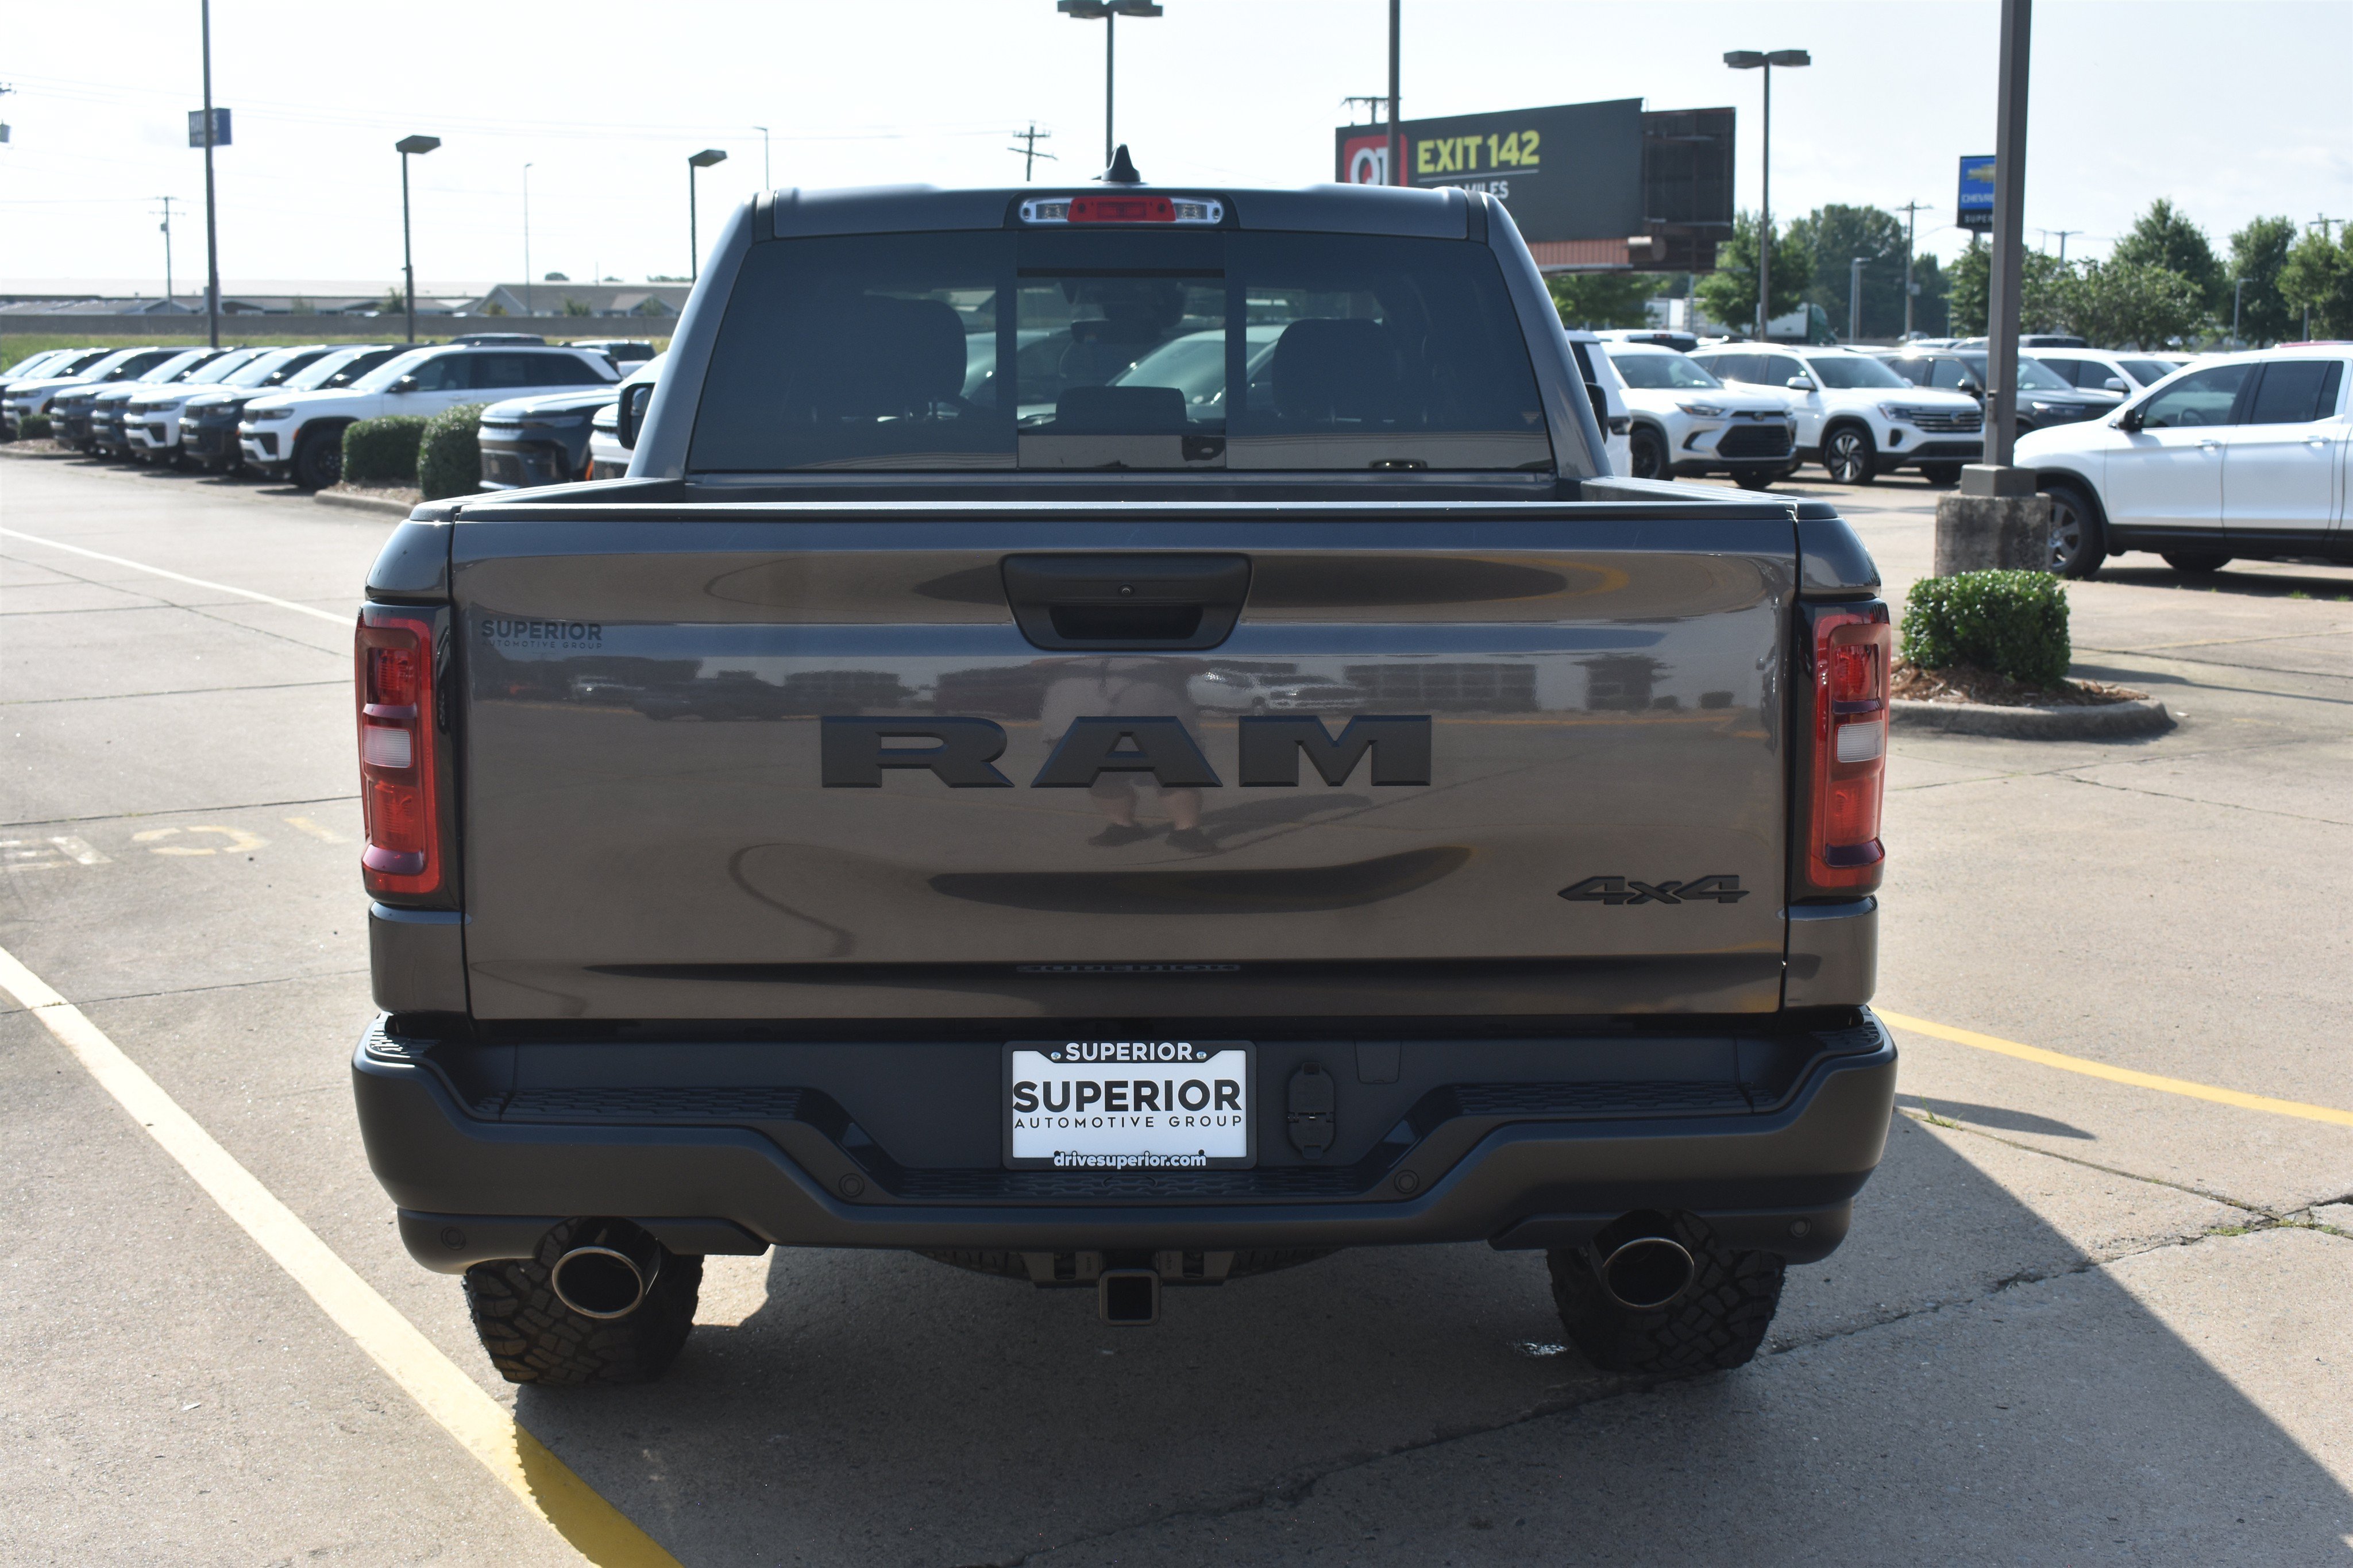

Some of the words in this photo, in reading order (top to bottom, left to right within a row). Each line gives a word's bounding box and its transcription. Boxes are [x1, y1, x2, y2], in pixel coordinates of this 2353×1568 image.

[1417, 135, 1483, 173] EXIT
[1487, 130, 1540, 168] 142
[1964, 214, 1993, 223] SUPER
[481, 620, 603, 640] SUPERIOR
[483, 640, 556, 648] AUTOMOTIVE
[562, 641, 602, 649] GROUP
[820, 715, 1432, 789] RAM
[1557, 874, 1750, 905] 4x4
[1065, 1042, 1193, 1061] SUPERIOR
[1013, 1079, 1243, 1113] SUPERIOR
[1015, 1117, 1155, 1129] AUTOMOTIVE
[1168, 1115, 1243, 1128] GROUP
[1054, 1150, 1207, 1169] drivesuperior.com
